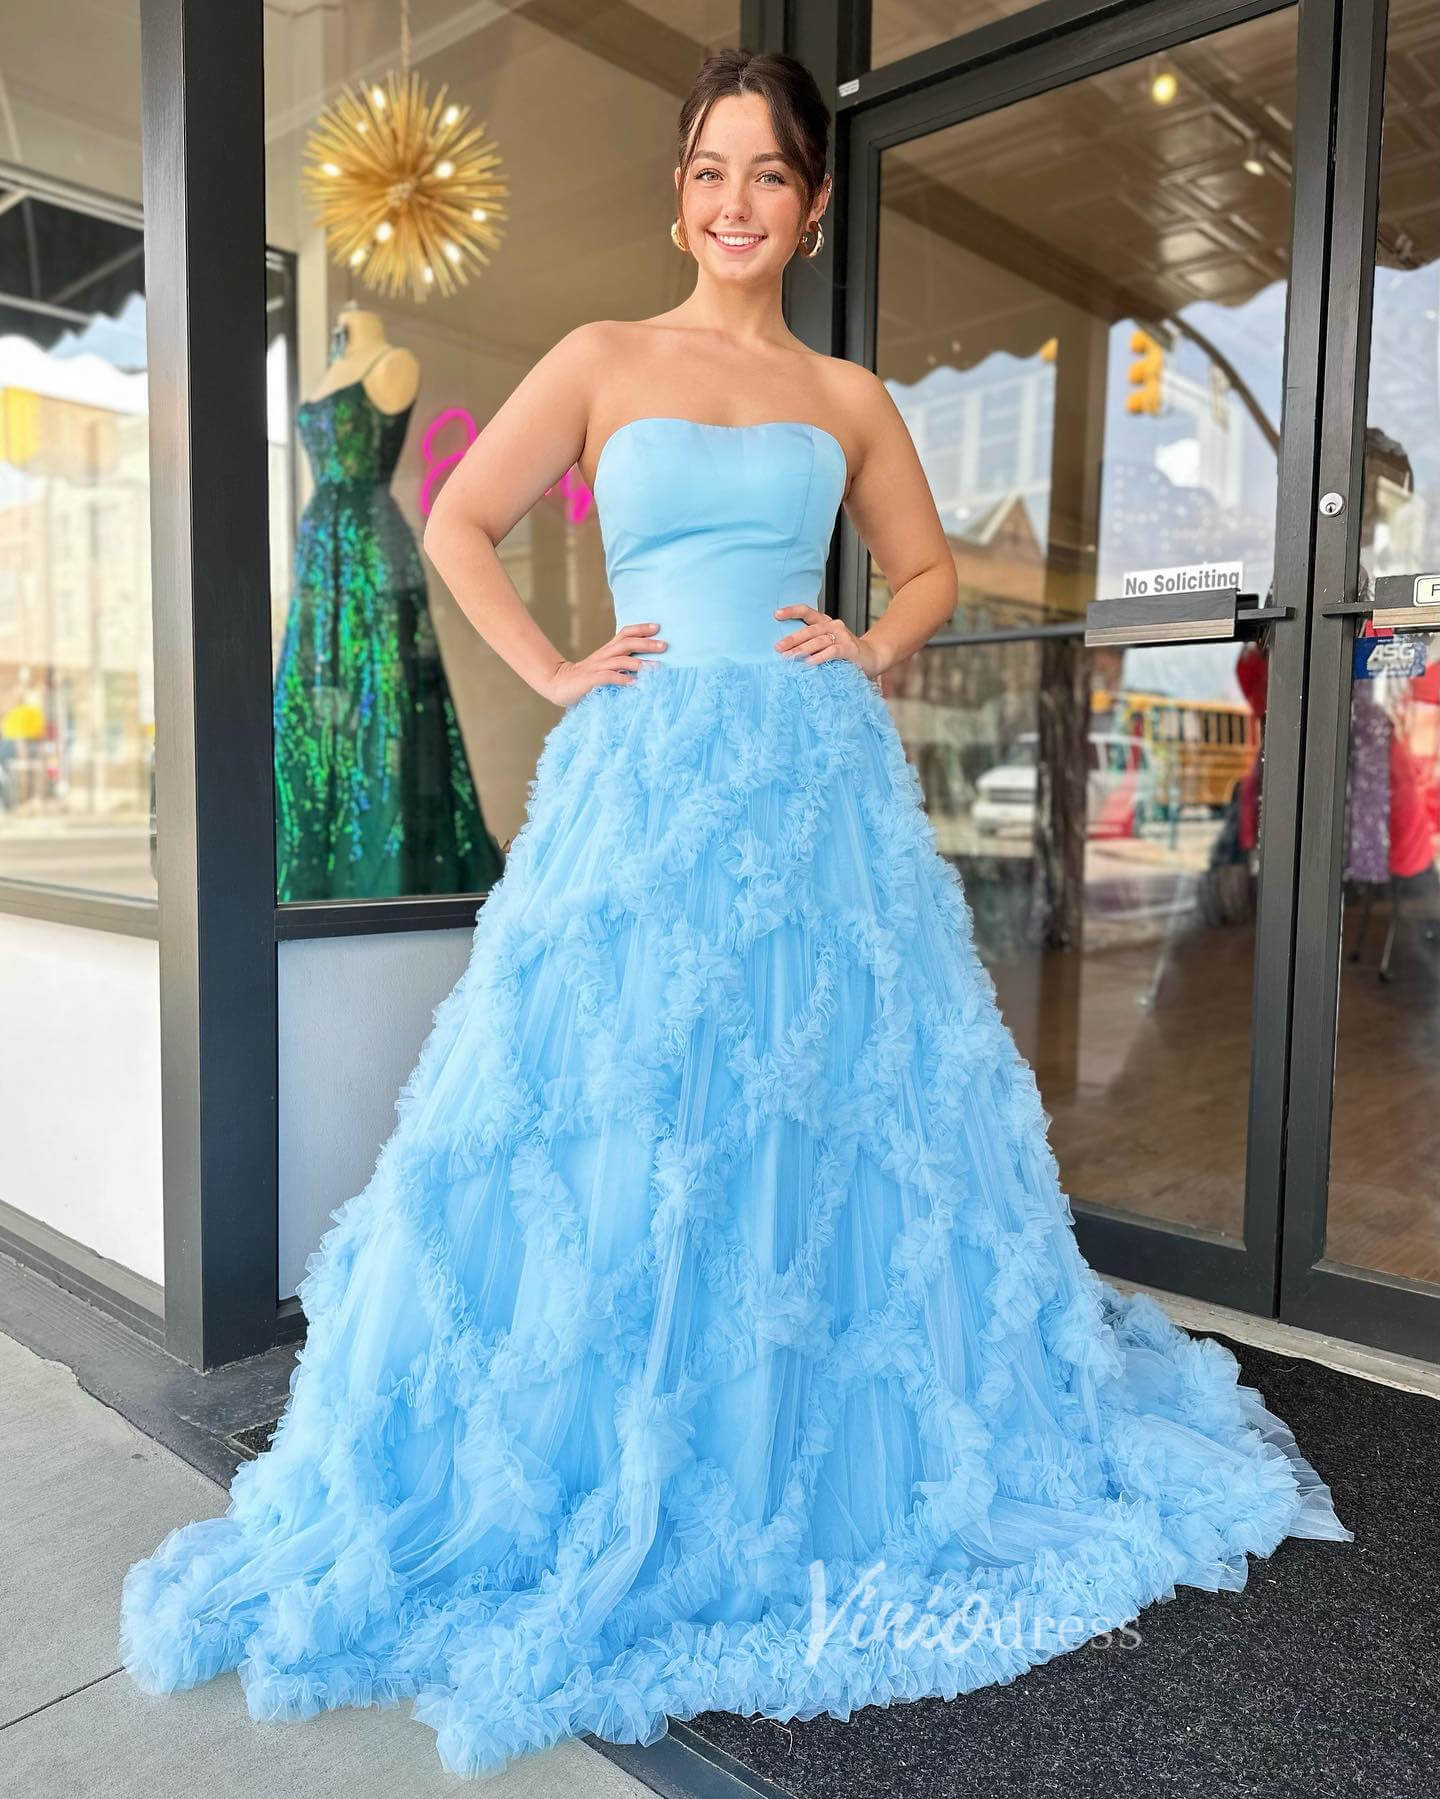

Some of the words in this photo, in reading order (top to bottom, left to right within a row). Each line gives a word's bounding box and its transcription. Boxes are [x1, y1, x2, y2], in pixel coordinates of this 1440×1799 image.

[1125, 577, 1148, 595] No
[1154, 569, 1240, 593] Soliciting
[1367, 643, 1416, 664] ASG
